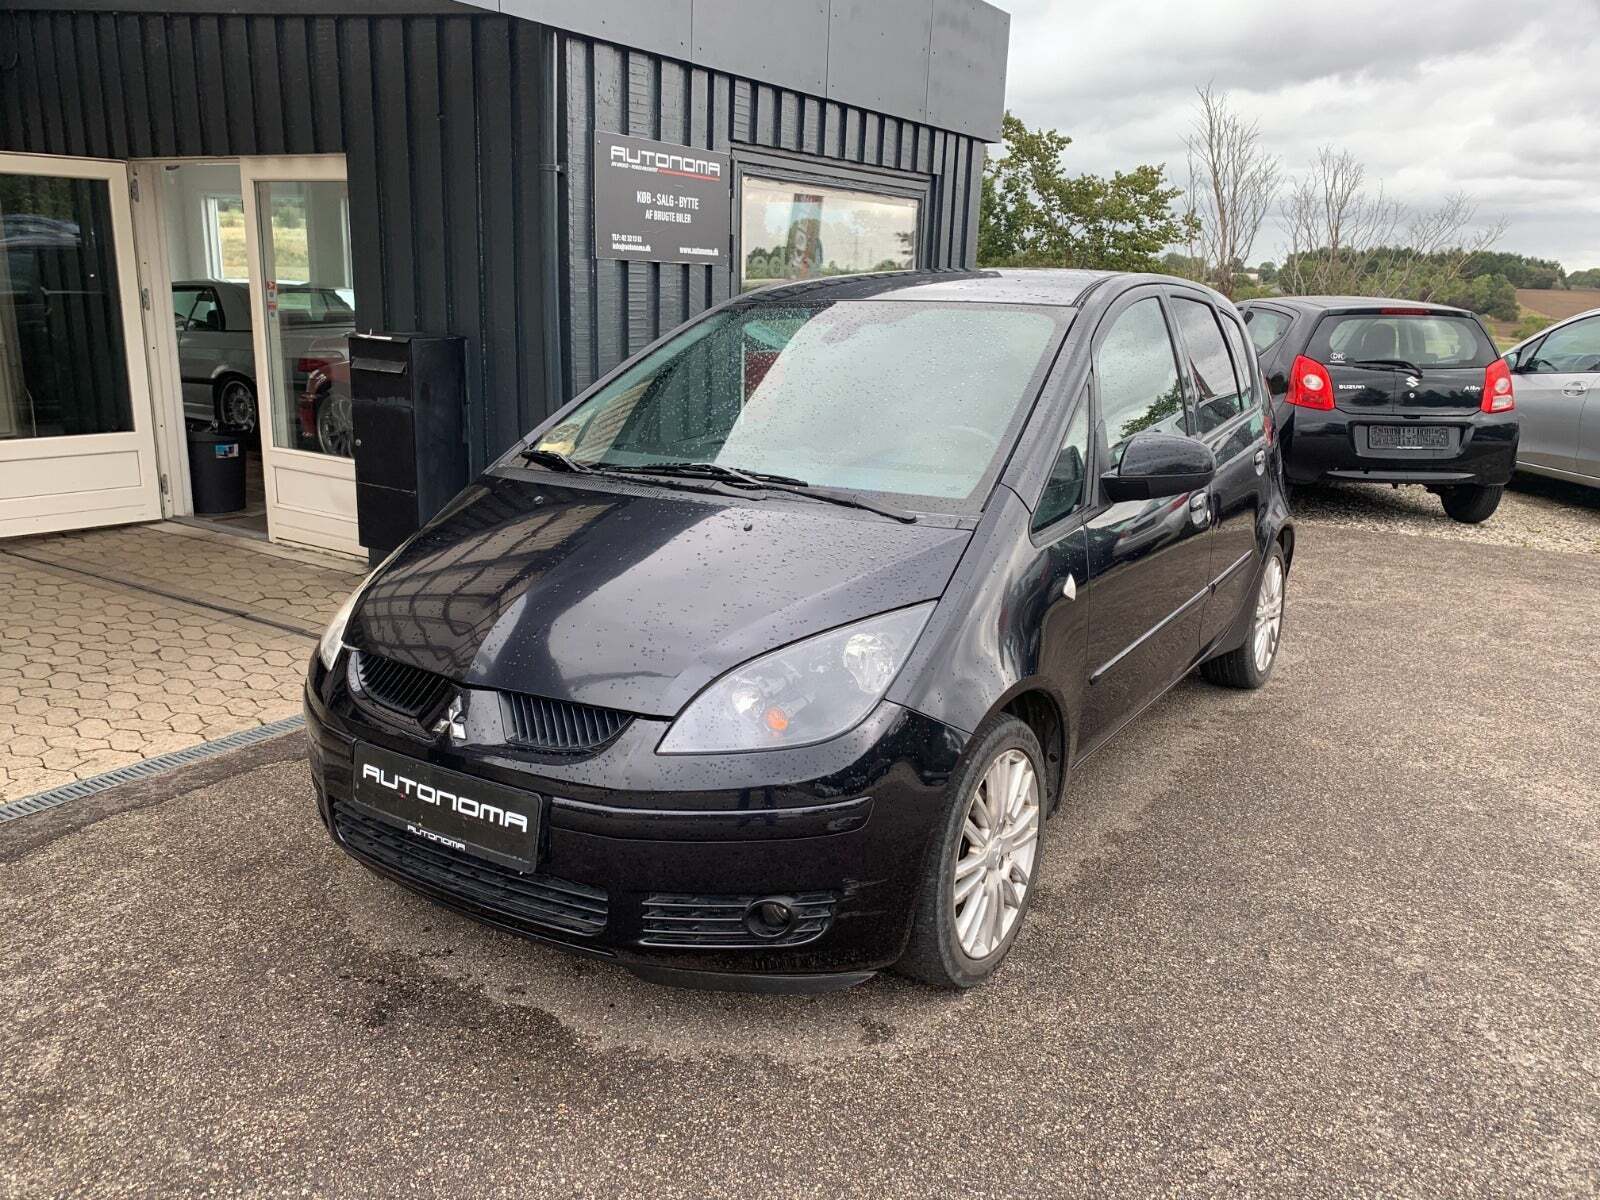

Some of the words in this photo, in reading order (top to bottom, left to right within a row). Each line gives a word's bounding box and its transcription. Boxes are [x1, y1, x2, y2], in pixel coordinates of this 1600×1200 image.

[611, 145, 720, 177] AUTONOMA
[636, 190, 652, 204] KØB
[656, 193, 674, 207] SALG
[678, 195, 700, 210] BYTTE
[645, 209, 654, 220] AF
[654, 211, 676, 223] BRUGTE
[676, 212, 692, 224] BILER
[362, 763, 528, 833] AUTONOMA
[407, 824, 466, 852] AUTONOMA
